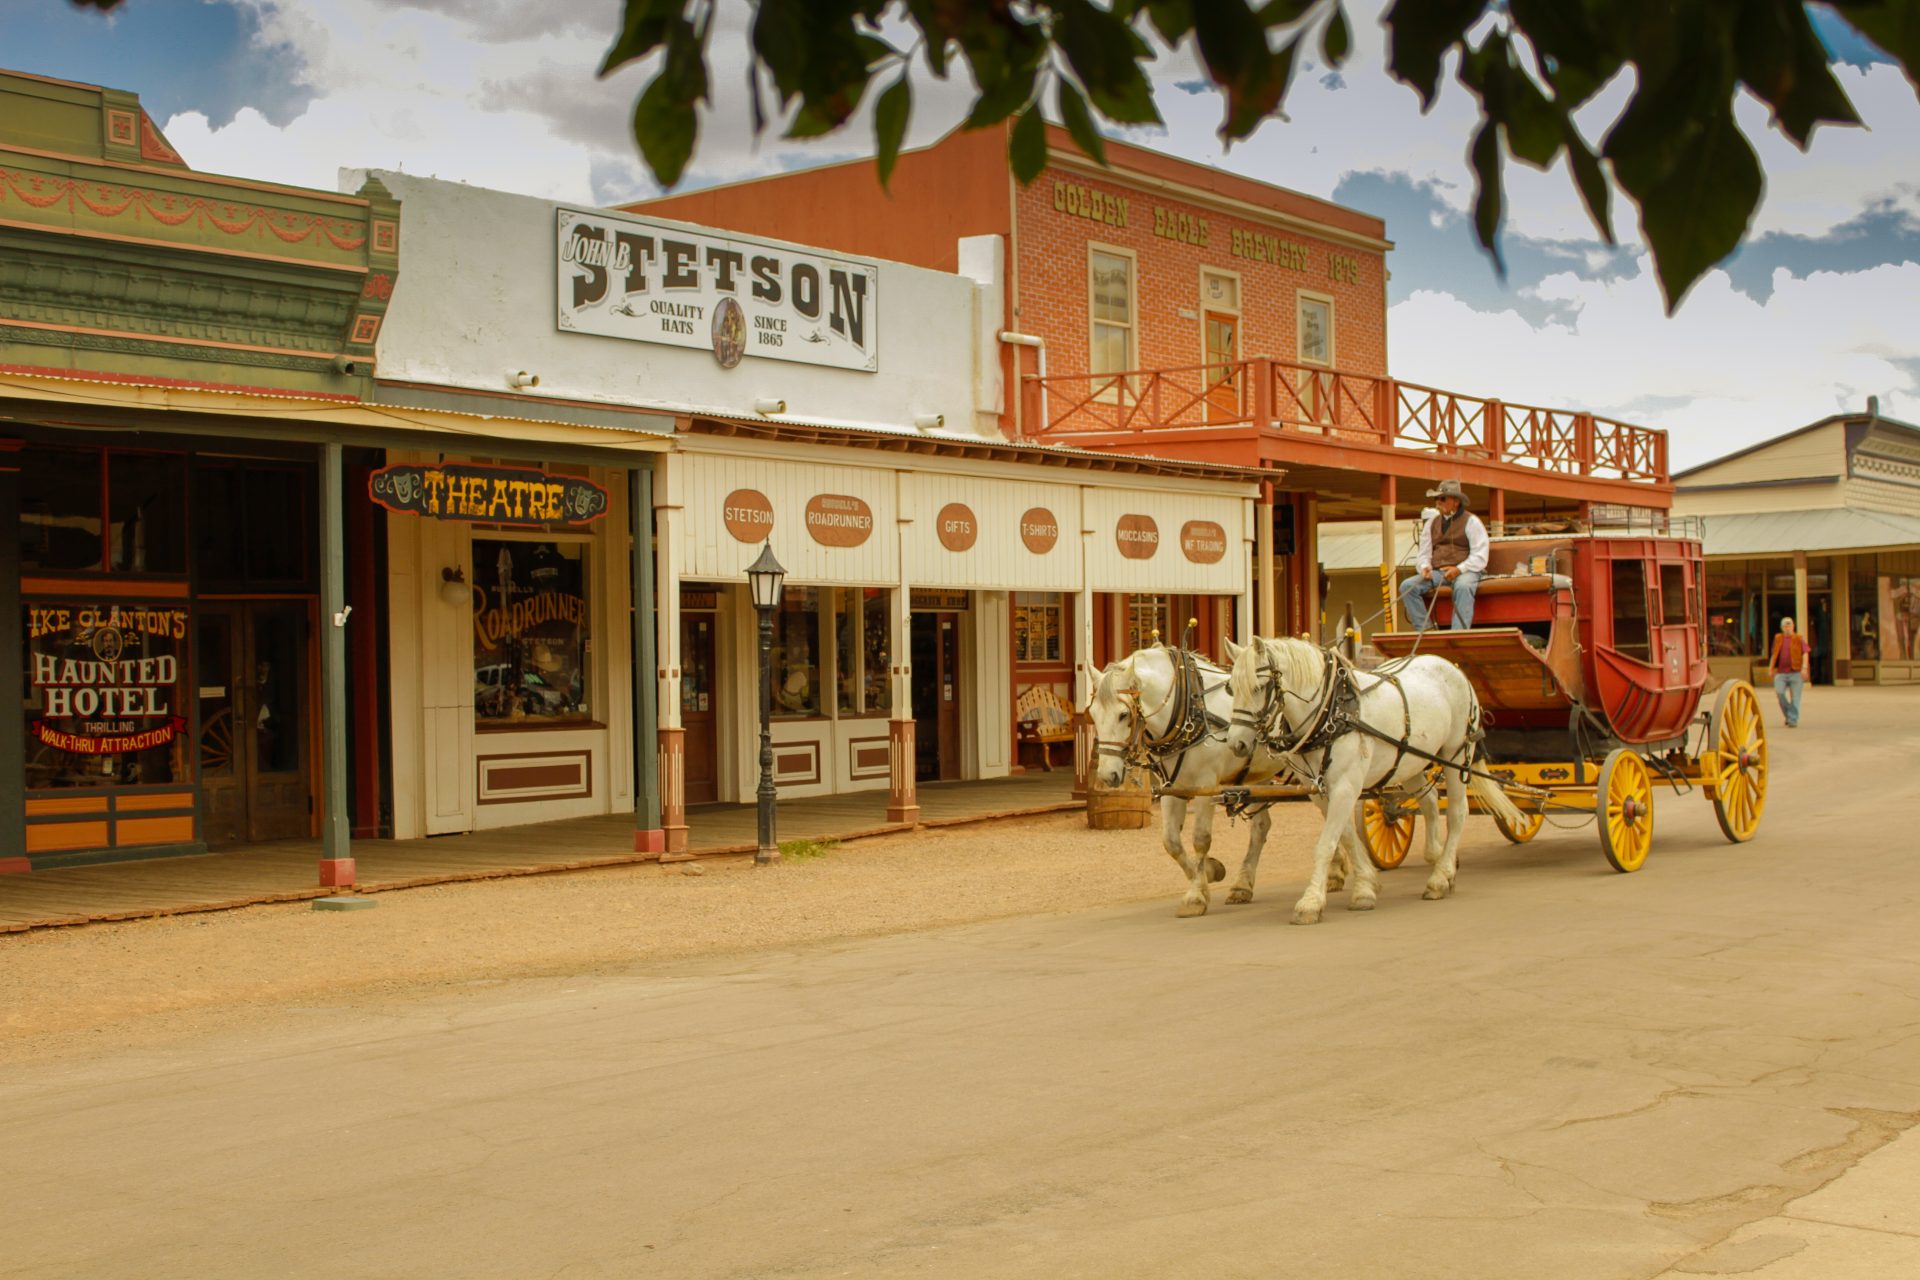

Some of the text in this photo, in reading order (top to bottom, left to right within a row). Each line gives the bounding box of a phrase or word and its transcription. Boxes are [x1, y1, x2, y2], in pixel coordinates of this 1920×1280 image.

[1054, 180, 1360, 285] GOLDEN EAGLE BREWERY 1879
[562, 232, 635, 272] JOHN B.
[572, 223, 867, 348] STETSON
[650, 299, 705, 320] QUALITY
[661, 318, 694, 335] HATS
[754, 315, 788, 333] SINCE
[758, 331, 784, 348] 1865
[424, 470, 564, 519] THEATRE
[725, 507, 774, 525] STETSON
[808, 511, 872, 529] ROADRUNNER
[945, 520, 971, 535] GIFTS
[1022, 523, 1058, 538] T-SHIRTS
[1117, 529, 1159, 544] MOCCASINS
[30, 608, 186, 640] IKE CLANTON'S
[472, 584, 586, 650] ROADRUNNER
[33, 652, 177, 685] HAUNTED
[45, 687, 168, 717] HOTEL
[84, 721, 135, 733] THRILLING
[40, 725, 172, 753] WALK-THRU ATTRACTION
